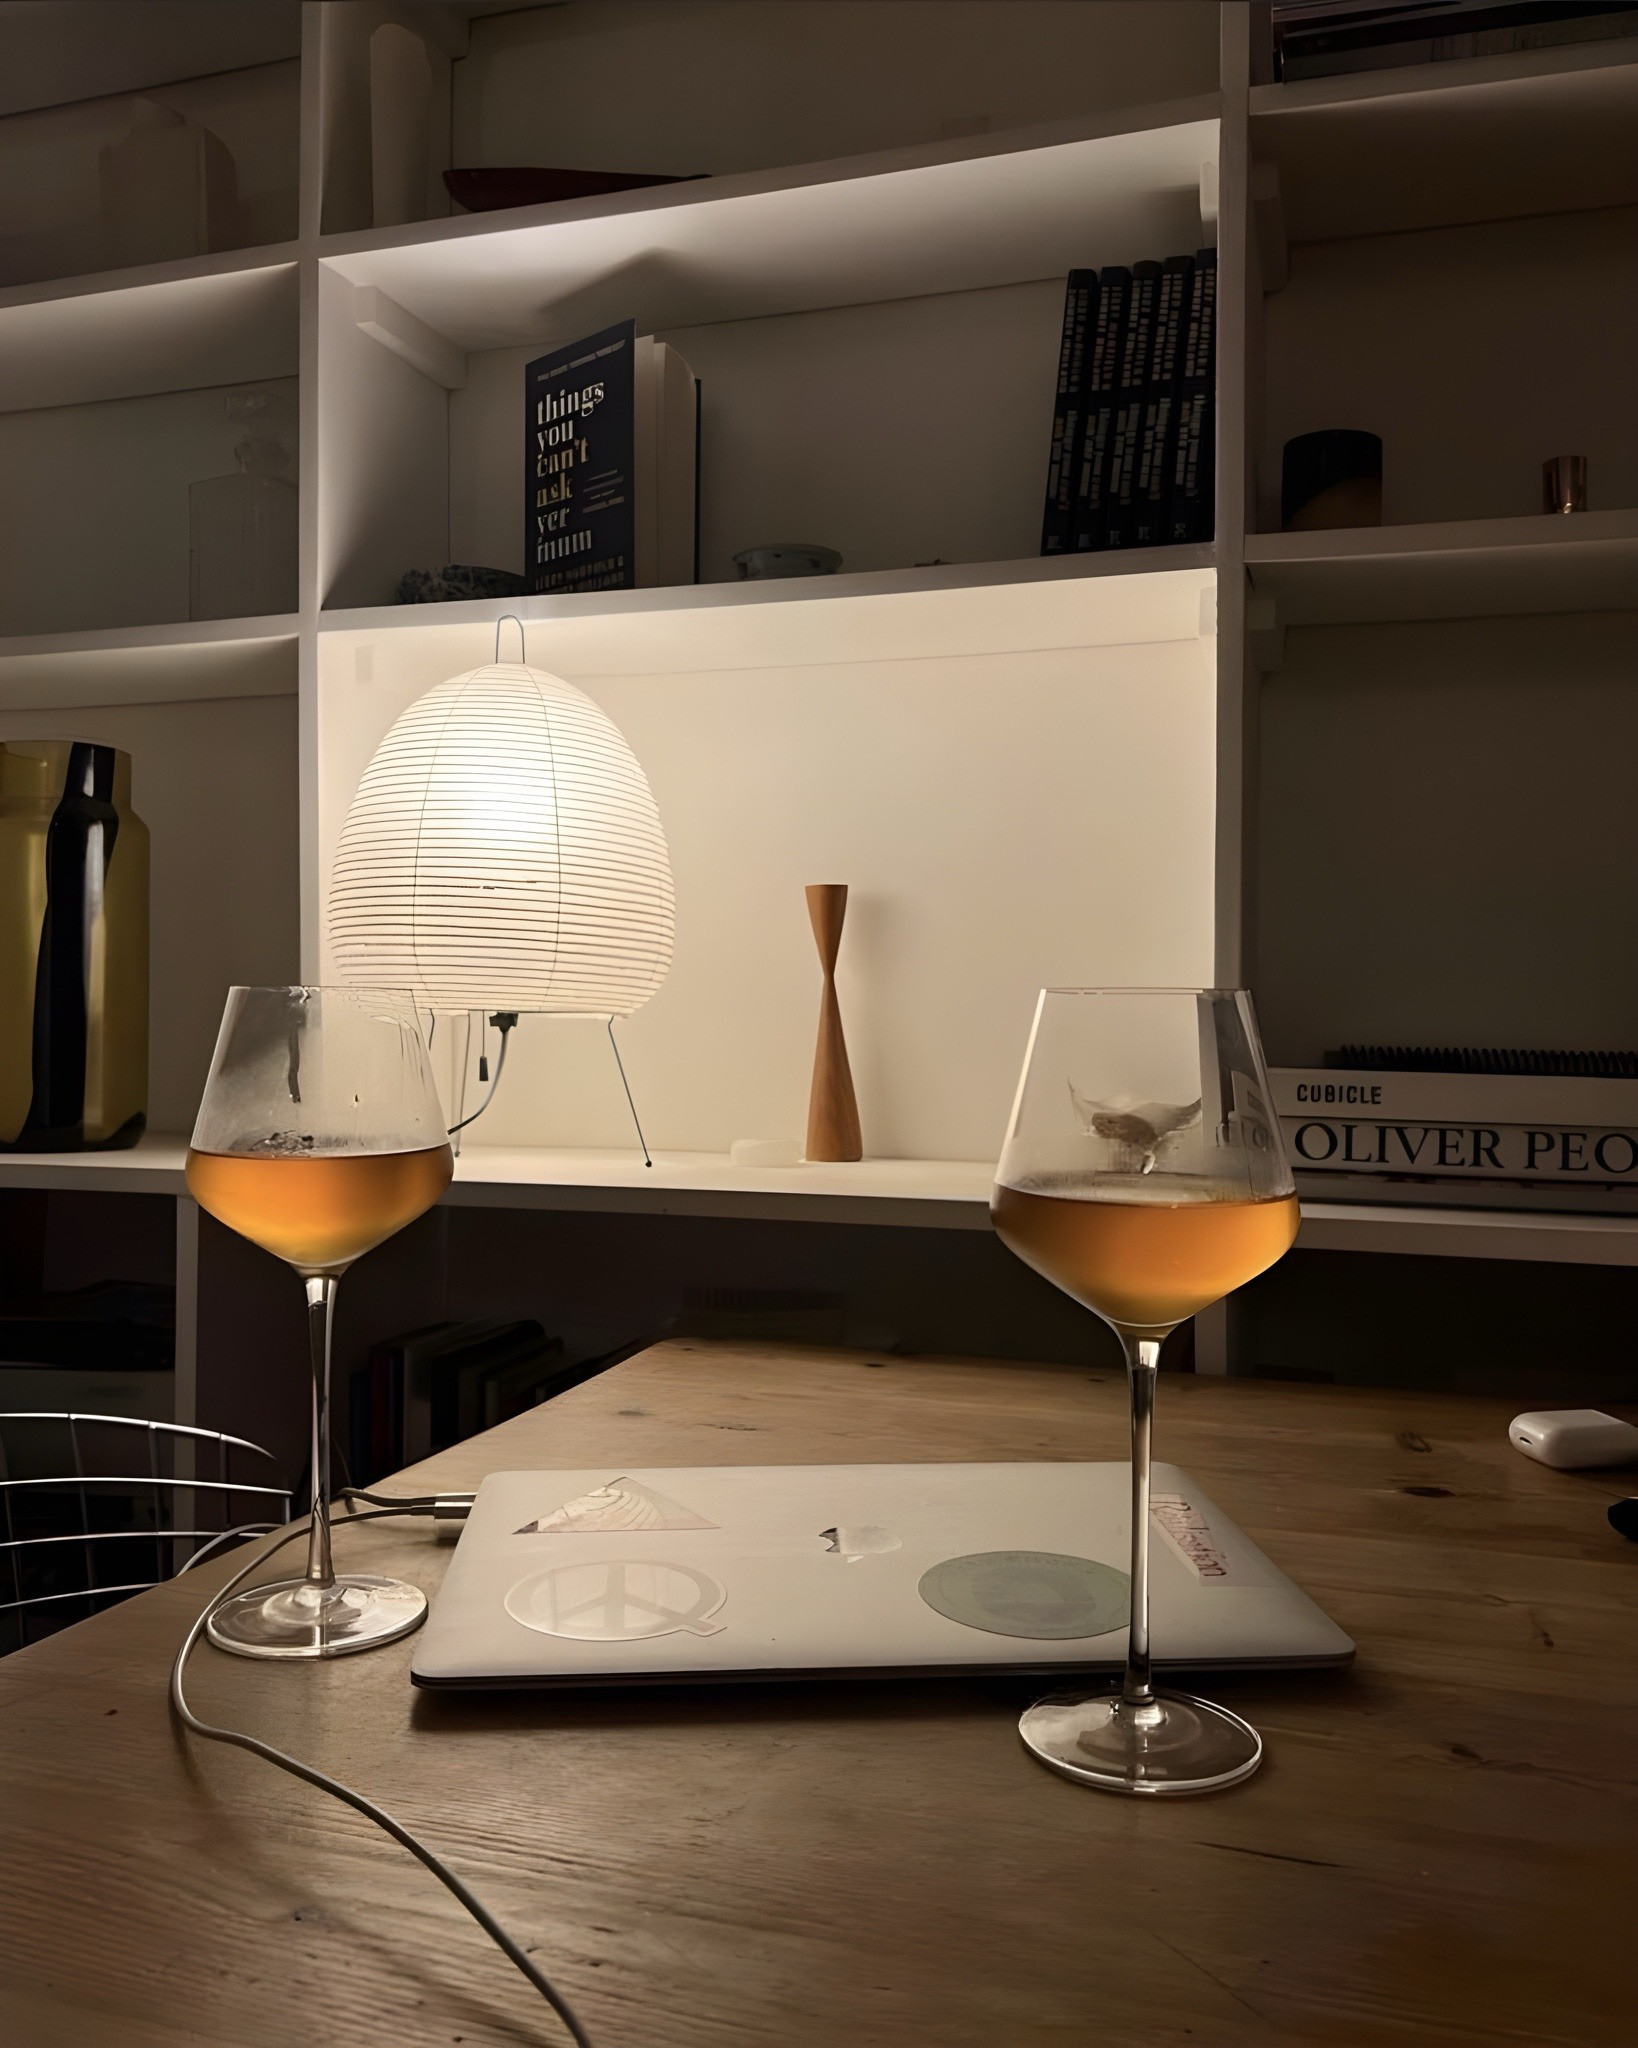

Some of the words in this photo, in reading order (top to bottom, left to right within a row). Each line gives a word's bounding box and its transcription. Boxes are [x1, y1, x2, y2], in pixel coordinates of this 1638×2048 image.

[538, 382, 604, 425] things
[538, 420, 574, 455] you
[1296, 1083, 1382, 1105] CUBICLE
[1294, 1122, 1505, 1169] OLIVER
